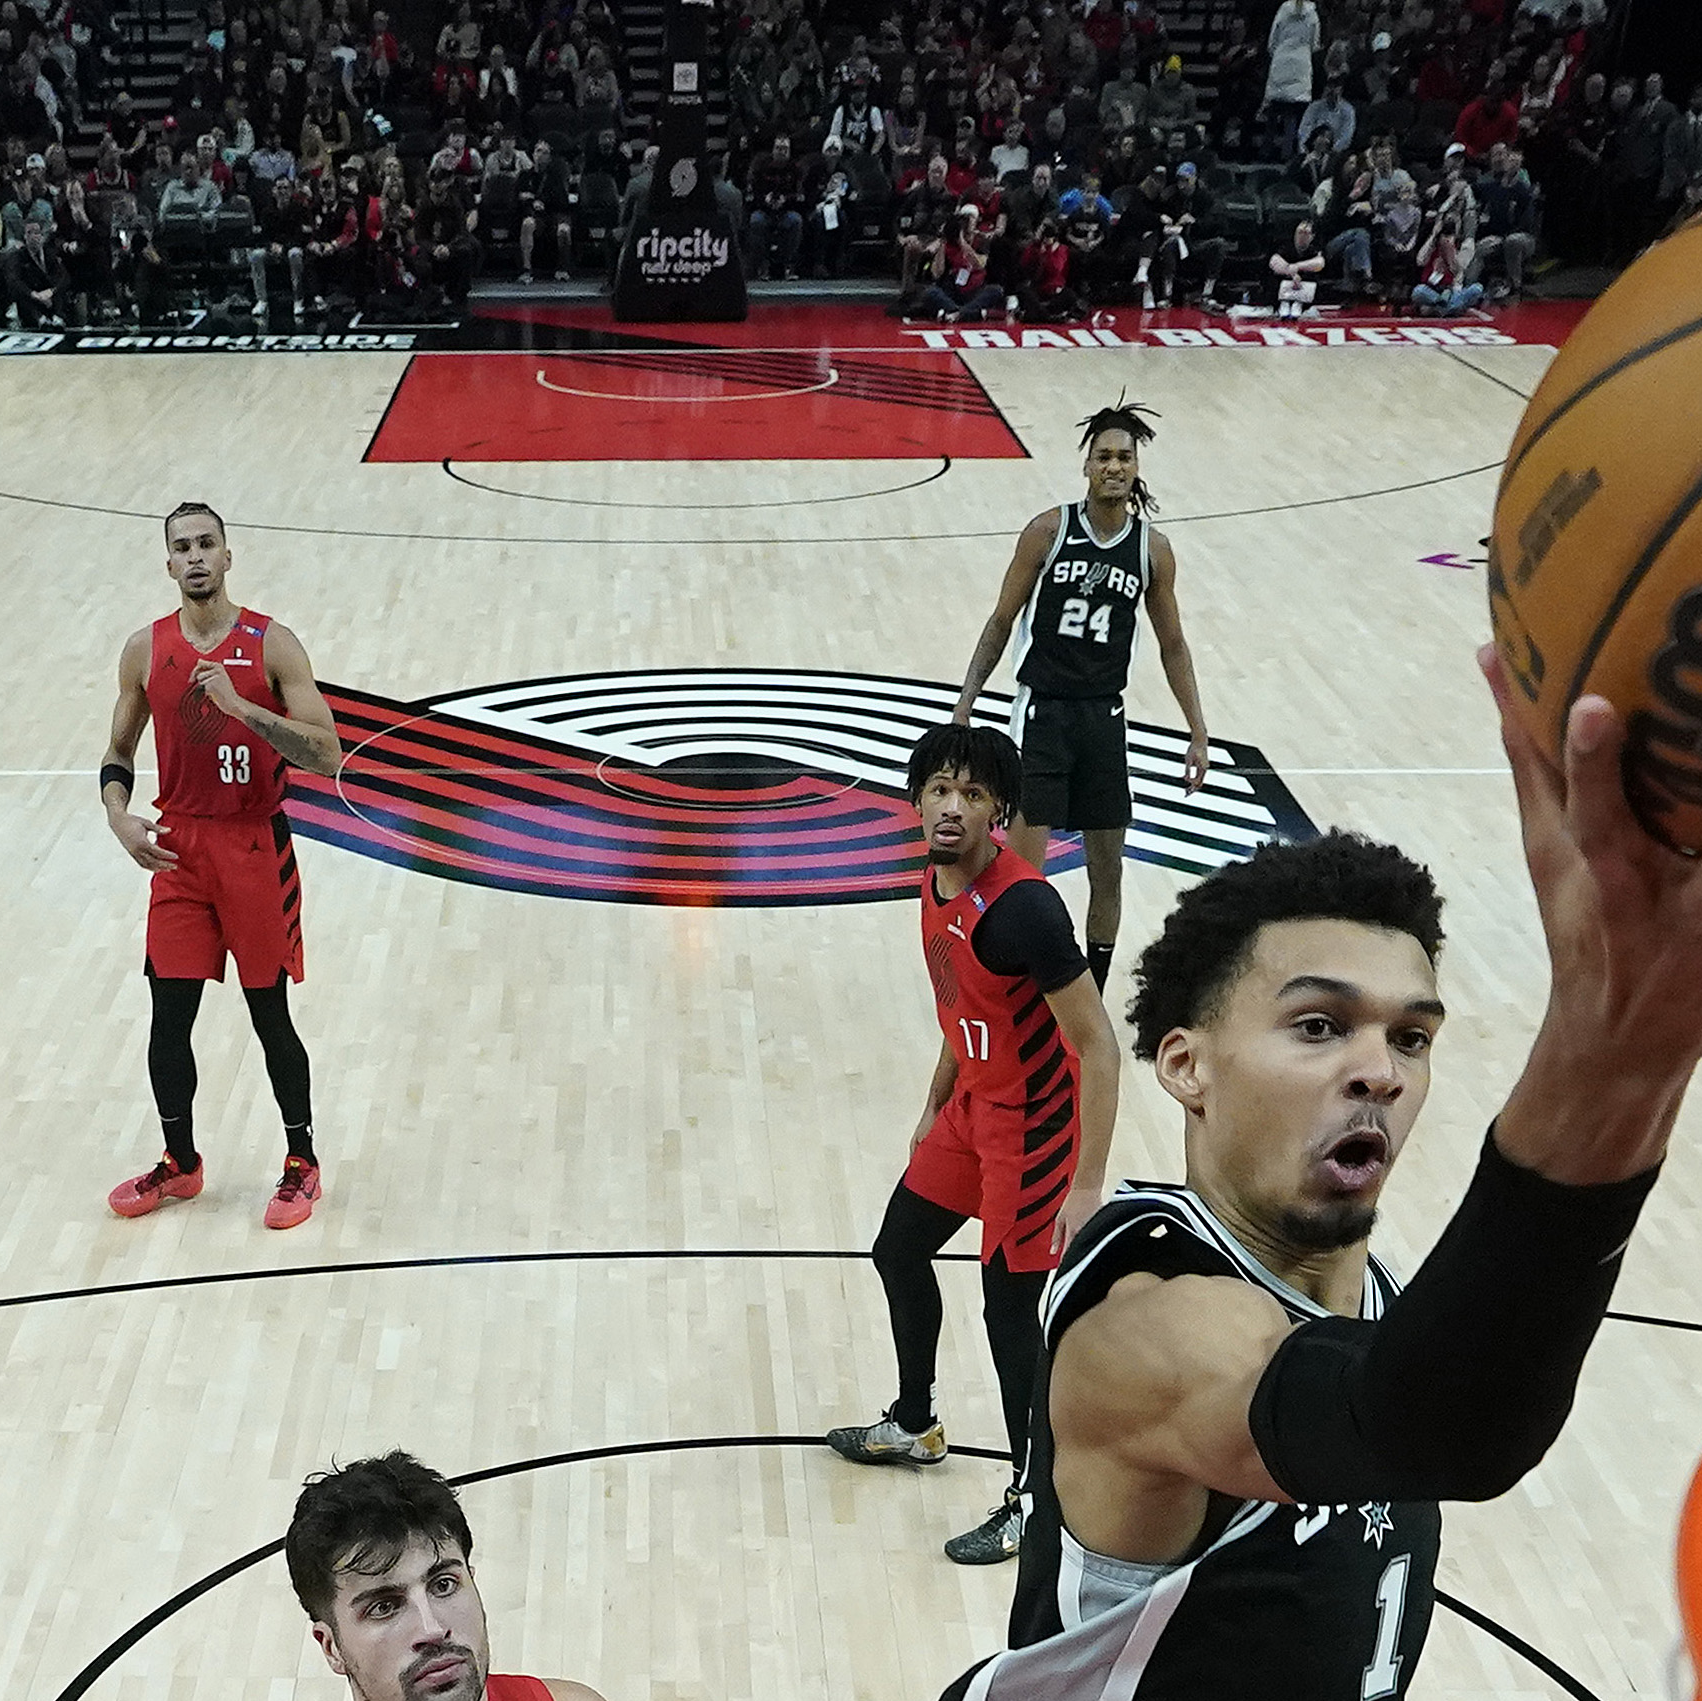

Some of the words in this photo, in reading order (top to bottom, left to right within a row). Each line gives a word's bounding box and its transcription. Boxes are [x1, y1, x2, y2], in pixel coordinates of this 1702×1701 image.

[636, 227, 729, 267] ripcity
[899, 329, 1148, 349] TRAIL
[1141, 325, 1518, 347] BLAZERS
[1057, 597, 1113, 644] 24
[217, 744, 252, 785] 33
[958, 1017, 991, 1062] 17
